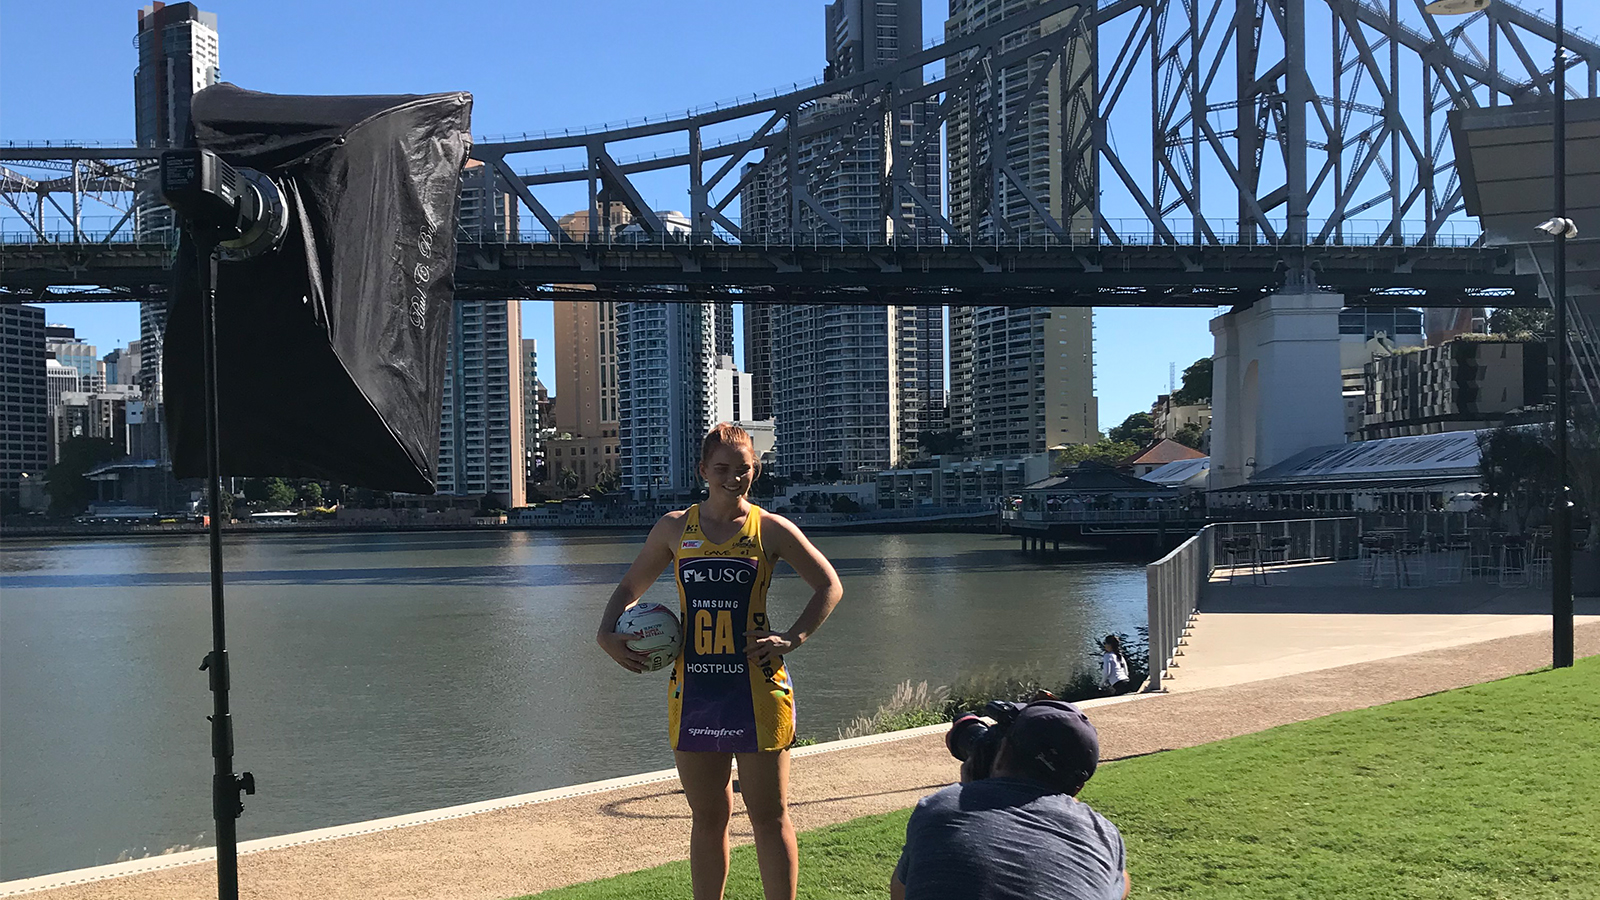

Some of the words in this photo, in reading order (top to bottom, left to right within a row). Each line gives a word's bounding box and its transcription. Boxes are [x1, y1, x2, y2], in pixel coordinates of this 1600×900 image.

[410, 287, 427, 329] Paul
[708, 568, 752, 584] USC
[692, 599, 739, 609] SAMSUNG
[694, 610, 735, 655] GA
[686, 663, 745, 674] HOSTPLUS
[688, 727, 745, 738] springfree
